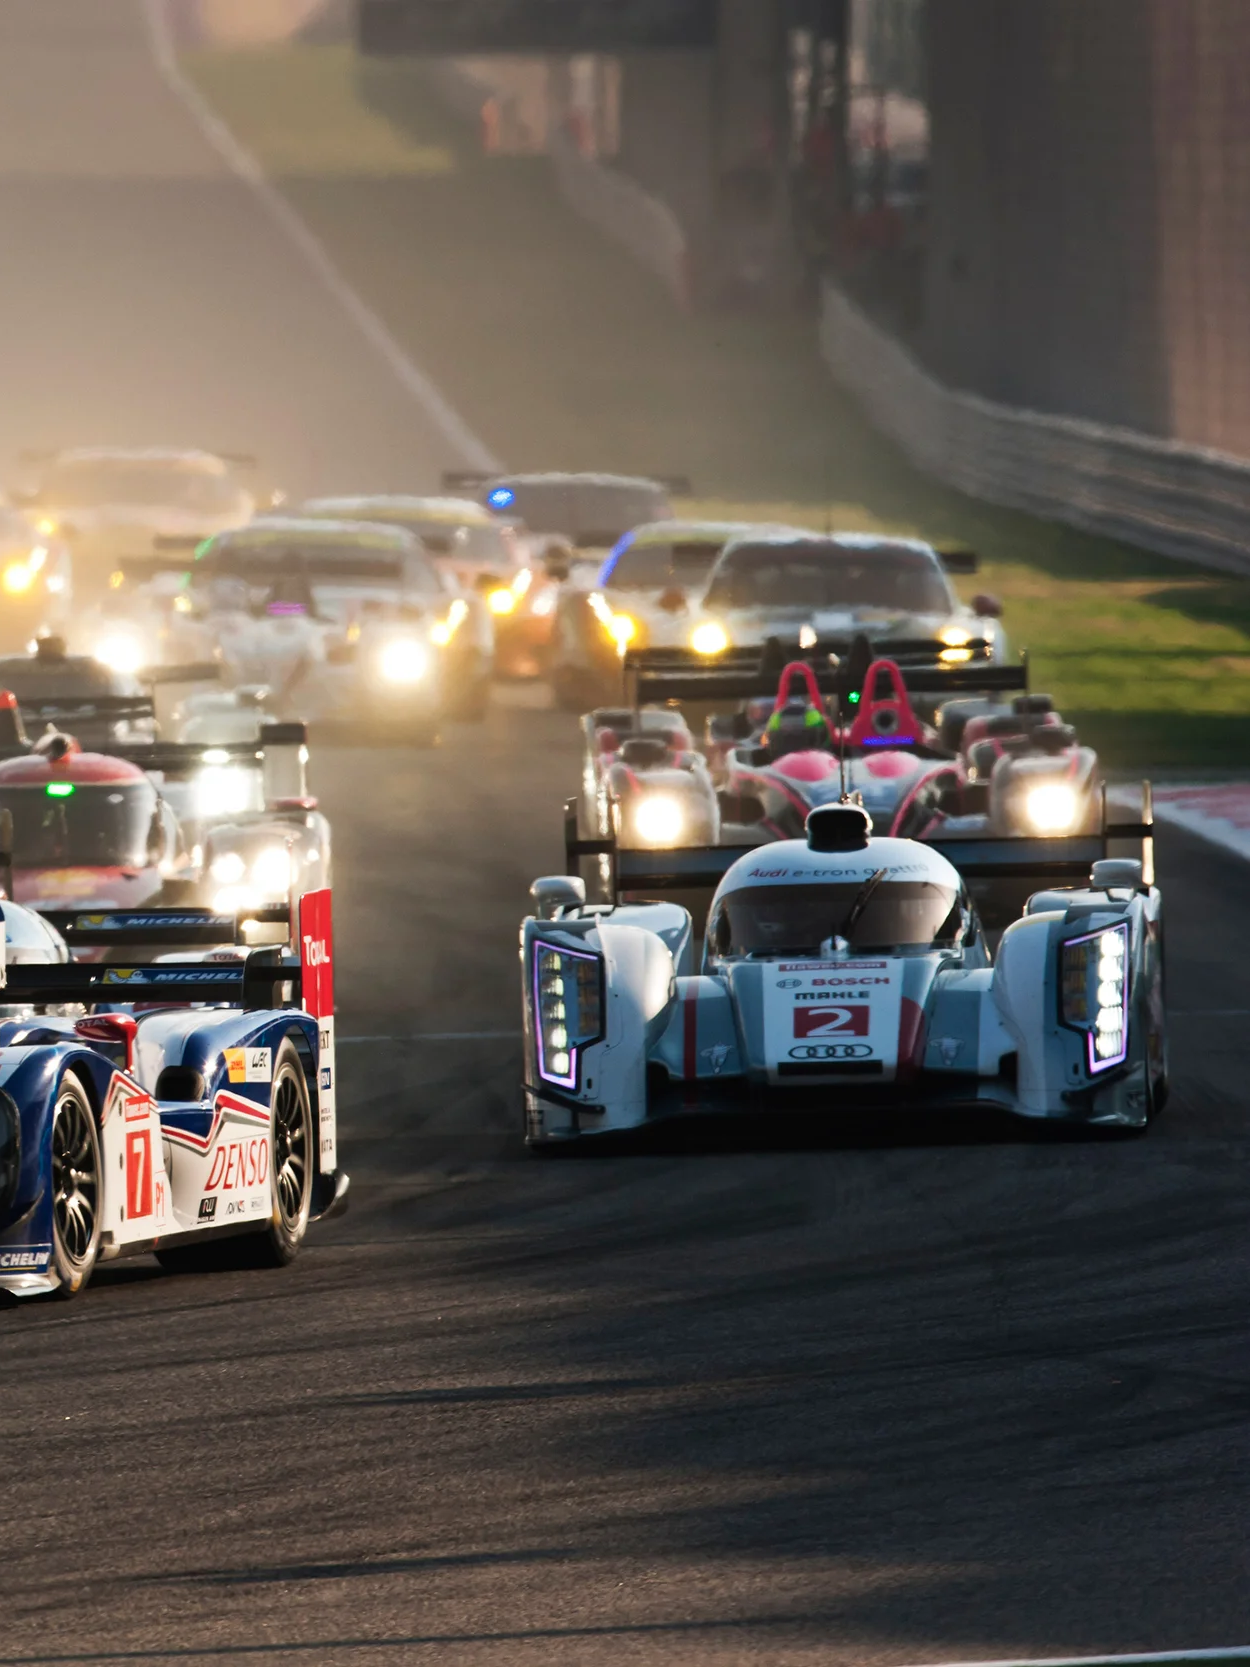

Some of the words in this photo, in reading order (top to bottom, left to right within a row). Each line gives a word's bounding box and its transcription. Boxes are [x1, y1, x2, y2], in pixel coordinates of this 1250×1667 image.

[748, 868, 787, 878] Audi
[793, 869, 857, 877] e-tron
[863, 865, 929, 878] qattro
[127, 917, 233, 925] MICHELIN
[155, 972, 243, 981] MICHEL
[812, 977, 890, 986] BOSCH
[795, 991, 870, 1000] MAHLE
[76, 1018, 109, 1029] OTAL
[806, 1008, 855, 1037] 2
[204, 1138, 268, 1191] DENSO
[133, 1137, 145, 1213] 7
